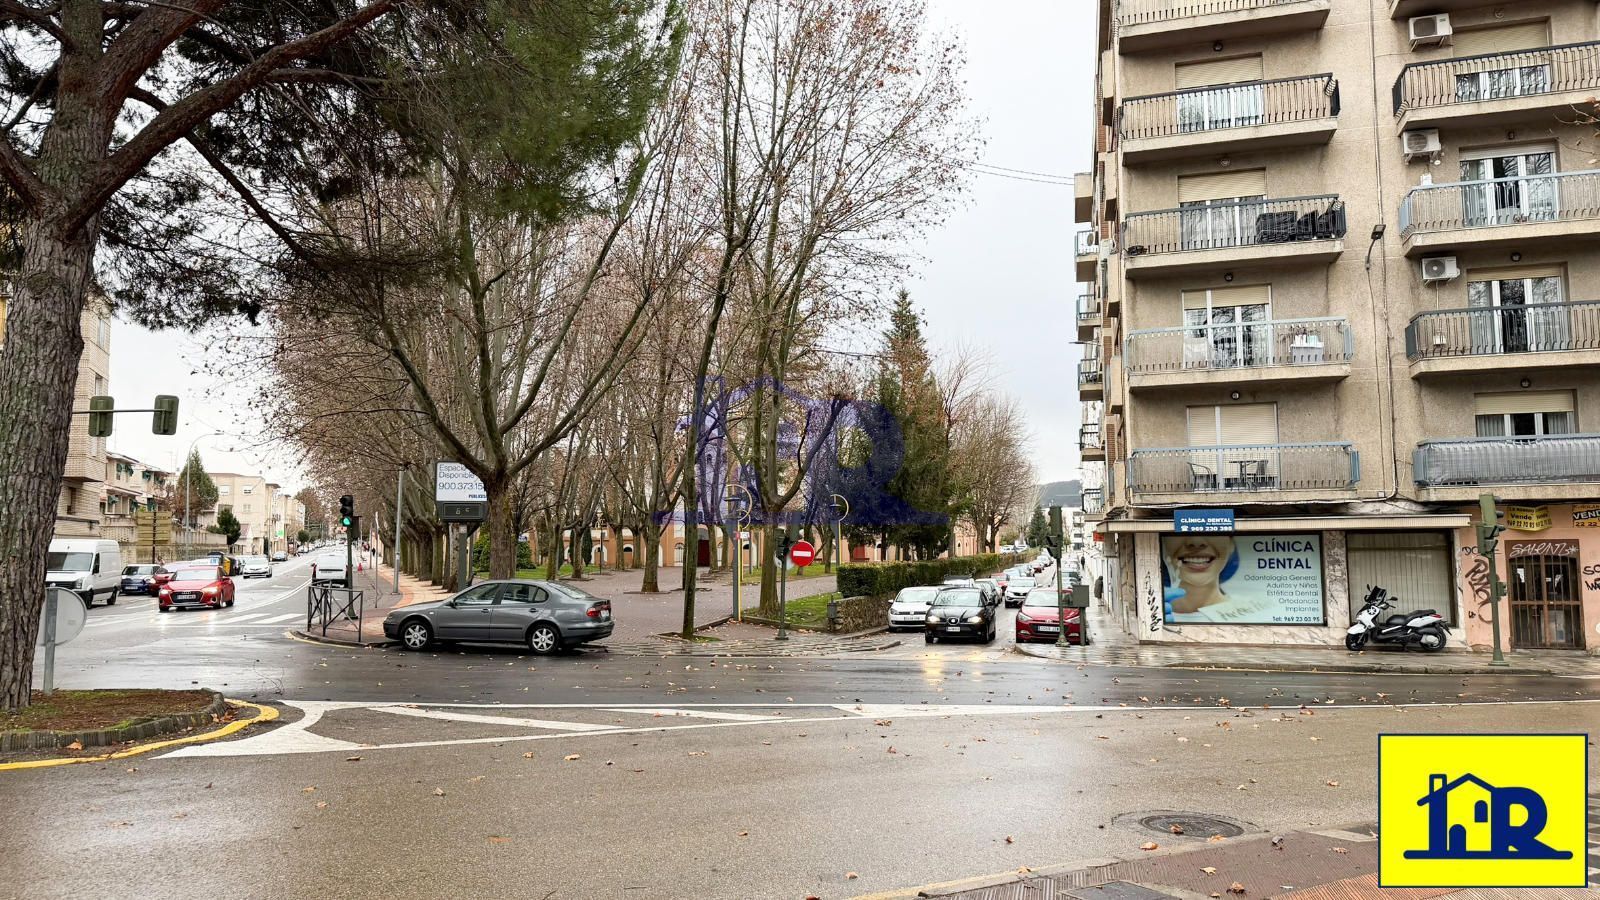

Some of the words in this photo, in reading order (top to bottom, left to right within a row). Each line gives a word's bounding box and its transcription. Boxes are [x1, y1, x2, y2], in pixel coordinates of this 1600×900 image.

[1253, 537, 1314, 553] CLÍNICA
[1257, 557, 1312, 569] DENTAL
[1278, 597, 1319, 605] Ortodoncia
